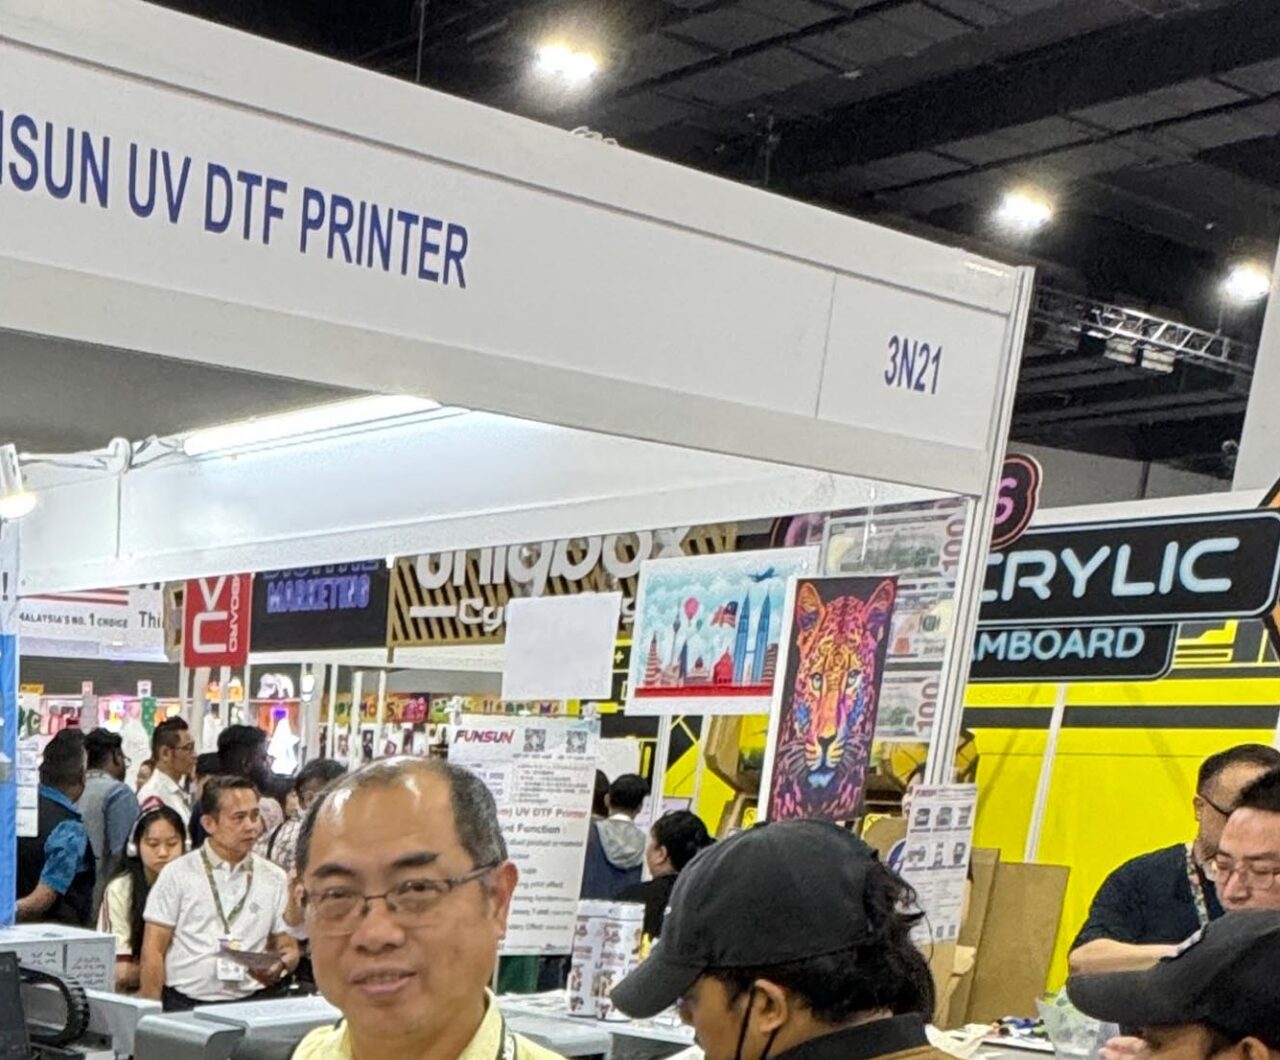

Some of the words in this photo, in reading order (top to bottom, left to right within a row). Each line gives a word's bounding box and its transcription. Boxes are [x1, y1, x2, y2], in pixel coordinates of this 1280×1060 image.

[128, 143, 192, 224] UV
[204, 162, 288, 245] DTF
[298, 187, 469, 289] PRINTER
[884, 335, 943, 395] 3N21
[89, 613, 96, 626] 1
[971, 627, 1145, 661] MBOARD
[454, 729, 515, 744] FUNSUN
